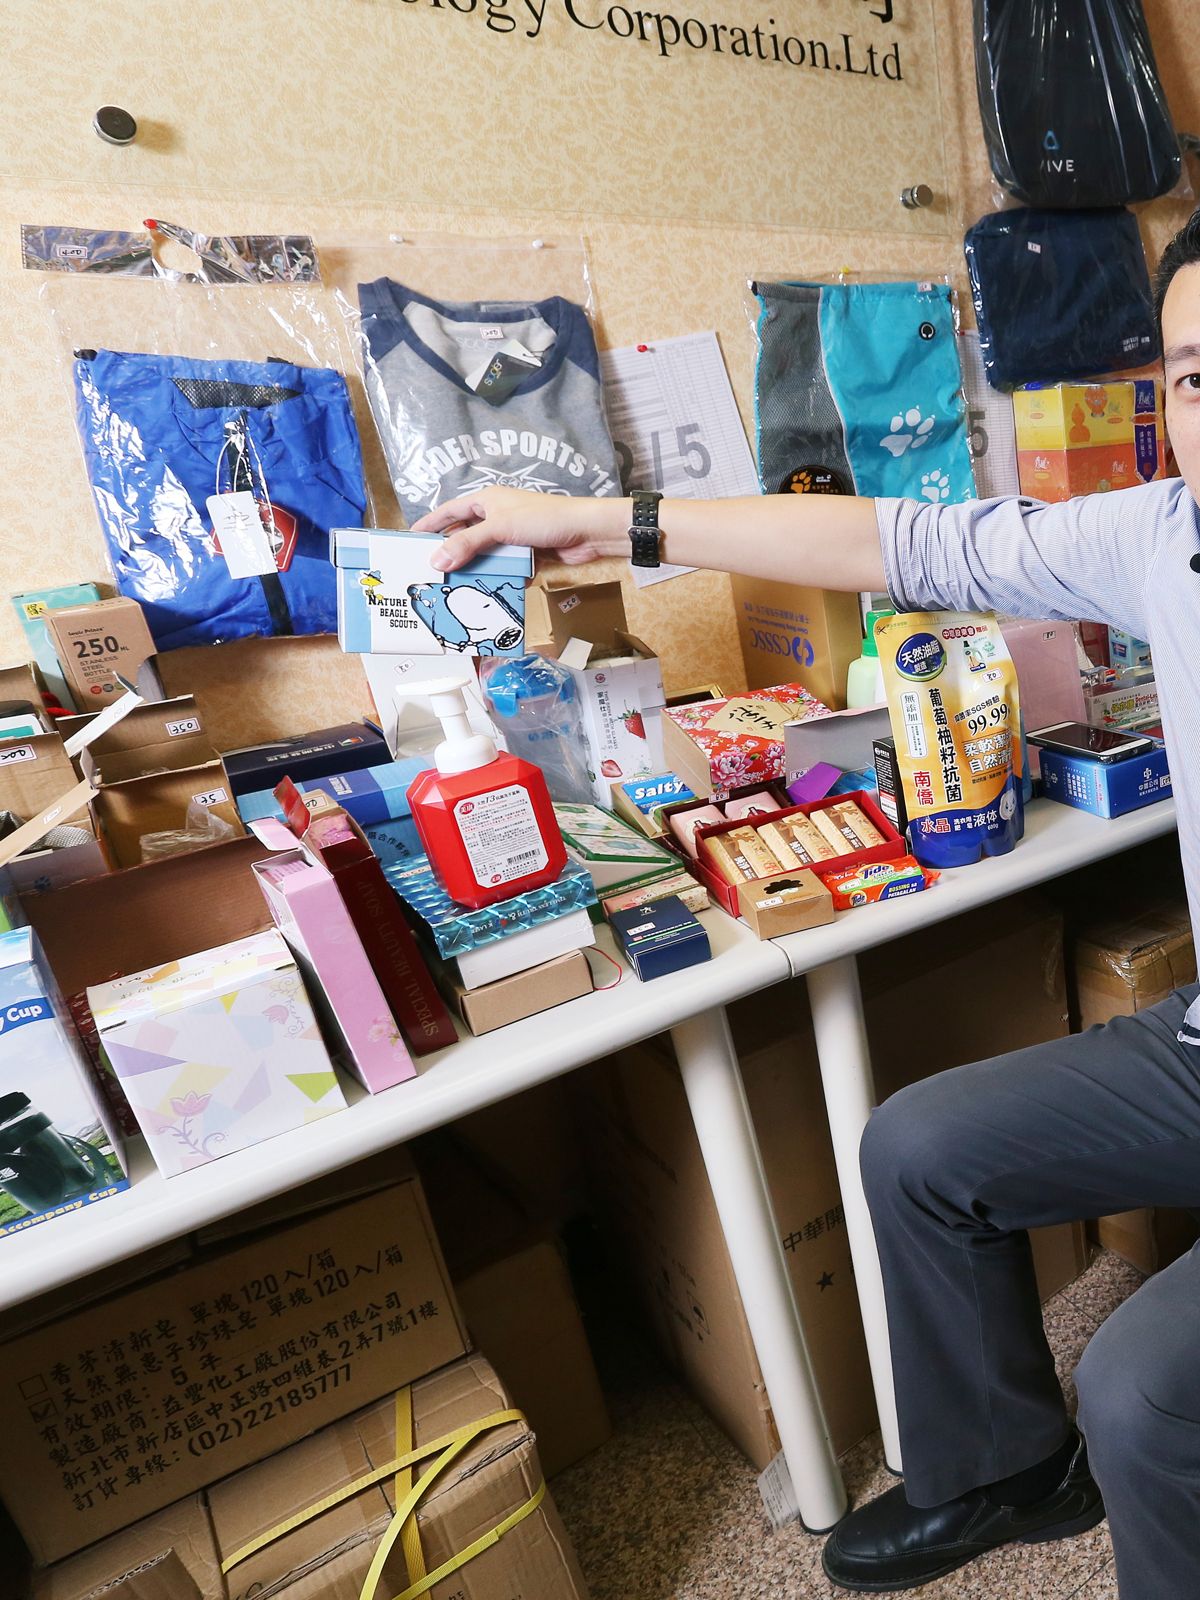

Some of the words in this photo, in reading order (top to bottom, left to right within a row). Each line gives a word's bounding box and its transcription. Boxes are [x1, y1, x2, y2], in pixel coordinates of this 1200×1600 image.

[563, 0, 904, 81] Corporation.Ltd
[483, 428, 589, 477] SPORTS
[368, 595, 408, 608] NATURE
[379, 608, 409, 619] BEAGLE
[389, 620, 418, 630] SCOUTS
[73, 635, 119, 659] 250
[901, 640, 941, 668] 天然油脂
[80, 655, 119, 667] STAINLESS
[81, 665, 104, 673] STEEL
[84, 668, 113, 678] BOTTLE
[903, 694, 919, 723] 無添加
[928, 688, 963, 803] 葡萄柚籽抗菌
[633, 777, 684, 800] Salty
[912, 770, 934, 805] 南僑
[921, 818, 951, 834] 水晶
[973, 810, 998, 828] 液体
[861, 864, 891, 880] Tide
[6, 1003, 44, 1023] Cup
[88, 1186, 118, 1201] Cup
[51, 1319, 178, 1386] 香茅清新皂
[189, 1247, 336, 1327] 單塊120入/箱
[63, 1308, 259, 1410] 天然無患子珍珠皂
[268, 1243, 404, 1319] 單塊120入/箱
[172, 1366, 188, 1388] 5
[199, 1350, 223, 1373] 年
